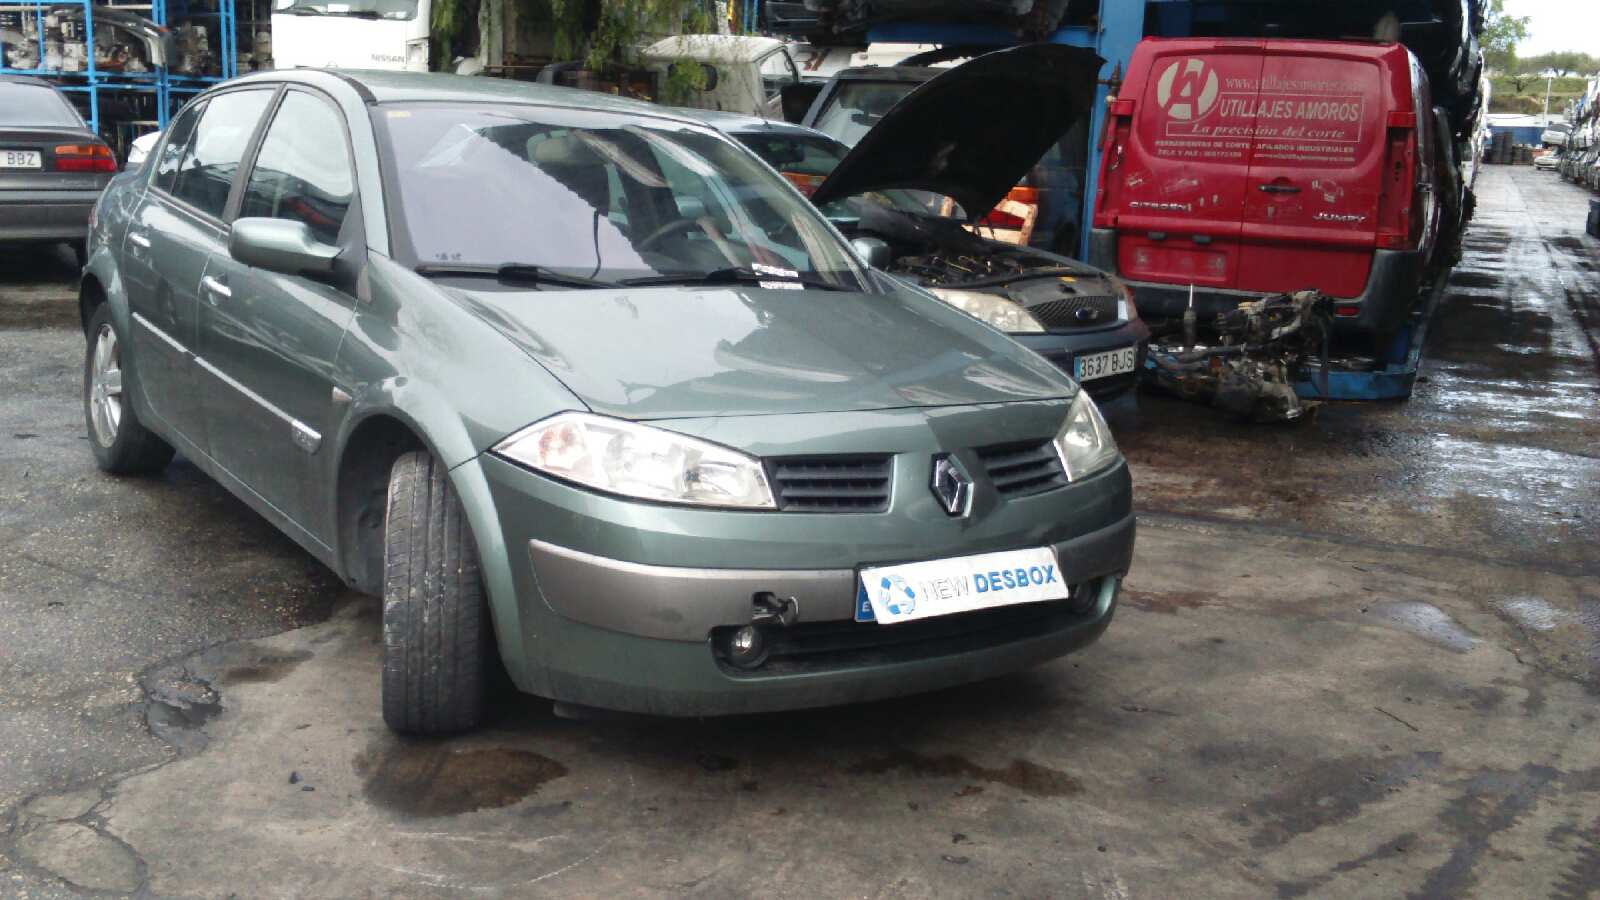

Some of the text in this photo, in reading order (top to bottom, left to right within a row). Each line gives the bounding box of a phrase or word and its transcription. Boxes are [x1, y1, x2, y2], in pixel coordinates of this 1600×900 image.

[1219, 98, 1360, 121] UTILLAJES AMOROS
[1281, 126, 1305, 137] del
[1307, 128, 1345, 138] corte
[7, 152, 35, 166] BBZ
[1080, 350, 1133, 377] 3637 BJS
[917, 565, 1057, 602] NEW DESBOX
